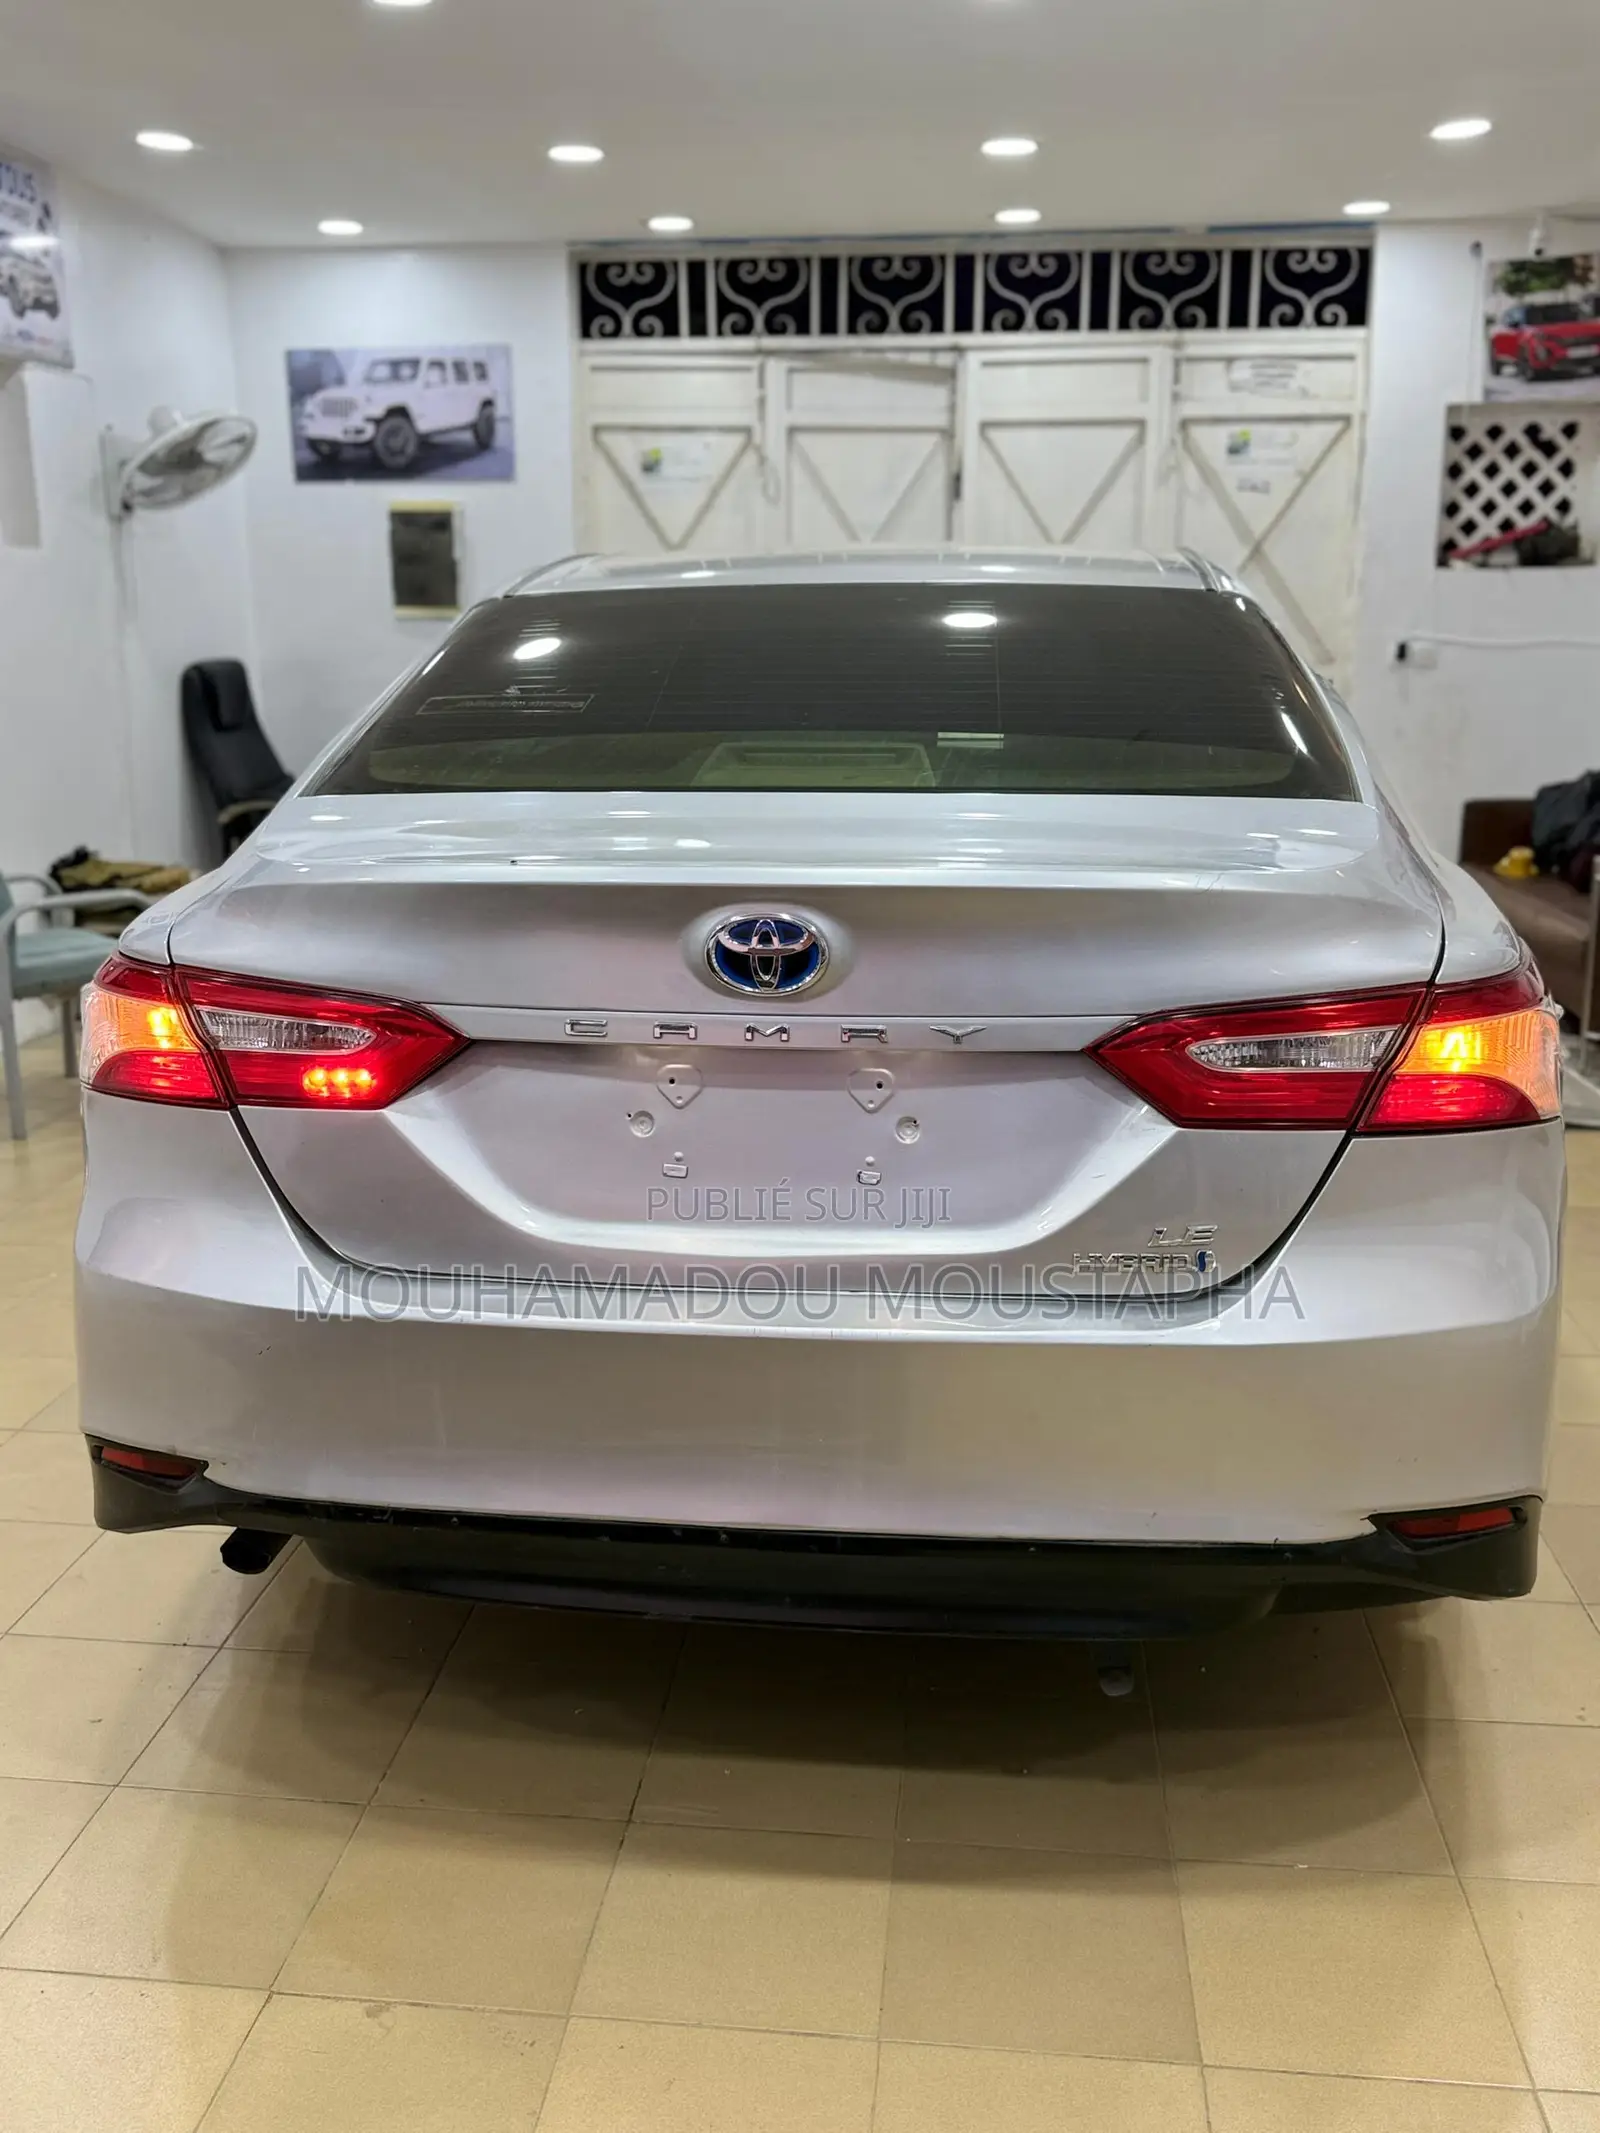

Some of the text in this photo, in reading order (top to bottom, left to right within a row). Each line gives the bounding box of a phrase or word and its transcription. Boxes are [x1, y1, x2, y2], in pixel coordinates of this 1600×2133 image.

[564, 1017, 988, 1044] CAMRY
[1148, 1224, 1218, 1247] LE
[1073, 1253, 1192, 1273] HYBRID
